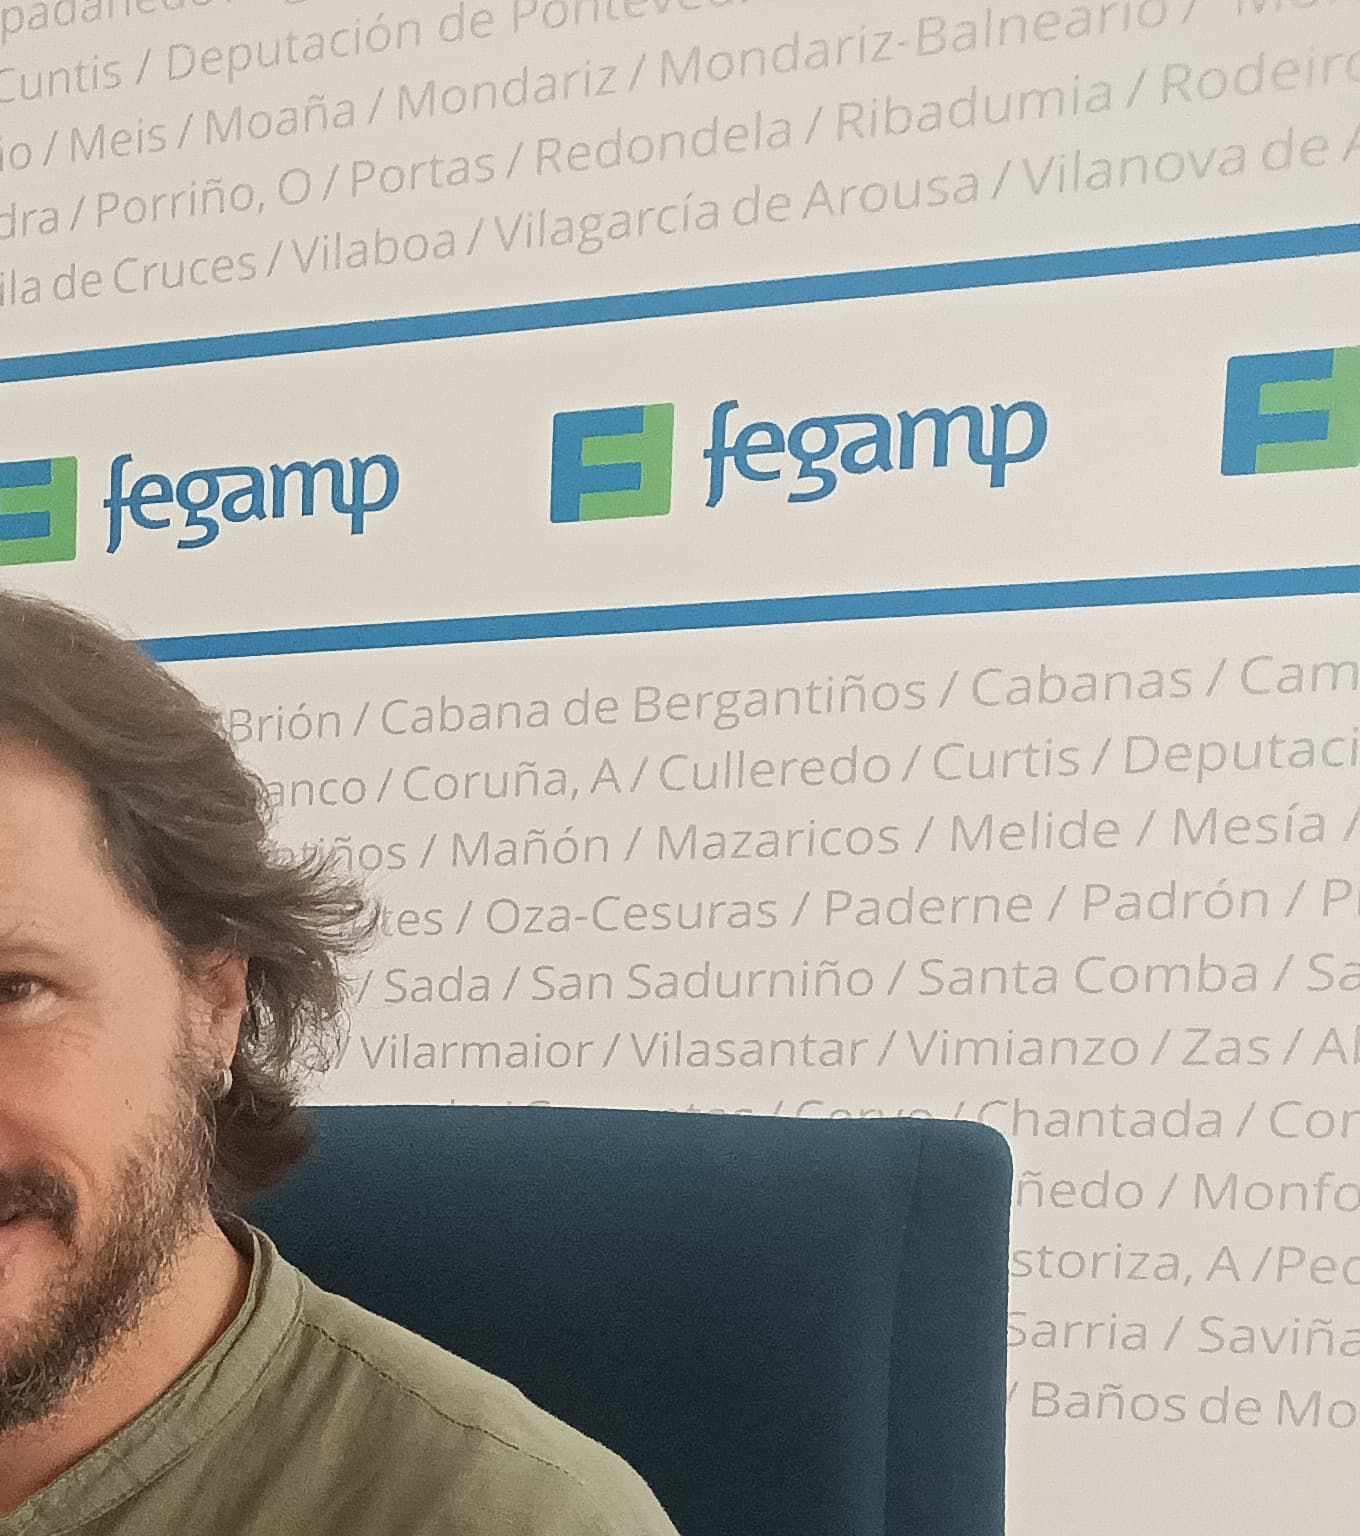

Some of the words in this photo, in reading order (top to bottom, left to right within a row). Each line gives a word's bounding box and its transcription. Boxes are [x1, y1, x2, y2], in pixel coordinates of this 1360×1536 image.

[97, 178, 264, 227] Porriño,
[279, 166, 311, 206] O
[352, 153, 494, 197] Portas
[537, 111, 791, 174] Redondela
[837, 76, 1111, 139] Ribadumia
[53, 262, 102, 301] de
[114, 251, 256, 294] Cruces
[292, 228, 455, 272] Vilaboa
[494, 192, 719, 253] Vilagarcía
[733, 183, 791, 227] de
[802, 172, 978, 218] Arousa
[1022, 144, 1245, 195] Vilanova
[1262, 126, 1329, 172] de
[704, 401, 1049, 509] fegamp
[104, 455, 401, 555] fegamp
[230, 702, 340, 742] Brión
[382, 695, 548, 735] Cabana
[564, 687, 618, 726] de
[634, 674, 925, 730] Bergantiños
[972, 664, 1192, 707] Cabanas
[404, 760, 578, 802] Coruña,
[590, 756, 621, 794] A
[660, 745, 890, 791] Culleredo
[934, 738, 1079, 781] Curtis
[487, 895, 777, 934] Oza-Cesuras
[826, 886, 1032, 926] Paderne
[1084, 878, 1268, 921] Padrón
[384, 965, 489, 1004] Sada
[532, 964, 612, 1001] San
[627, 959, 873, 1000] Sadurniño
[919, 957, 1057, 996] Santa
[1075, 953, 1257, 994] Comba
[361, 1032, 594, 1069] Vilarmaior
[630, 1030, 868, 1068] Vilasantar
[907, 1028, 1138, 1066] Vimianzo
[1182, 1026, 1269, 1066] Zas
[1032, 1380, 1185, 1422] Baños
[1200, 1385, 1261, 1426] de
